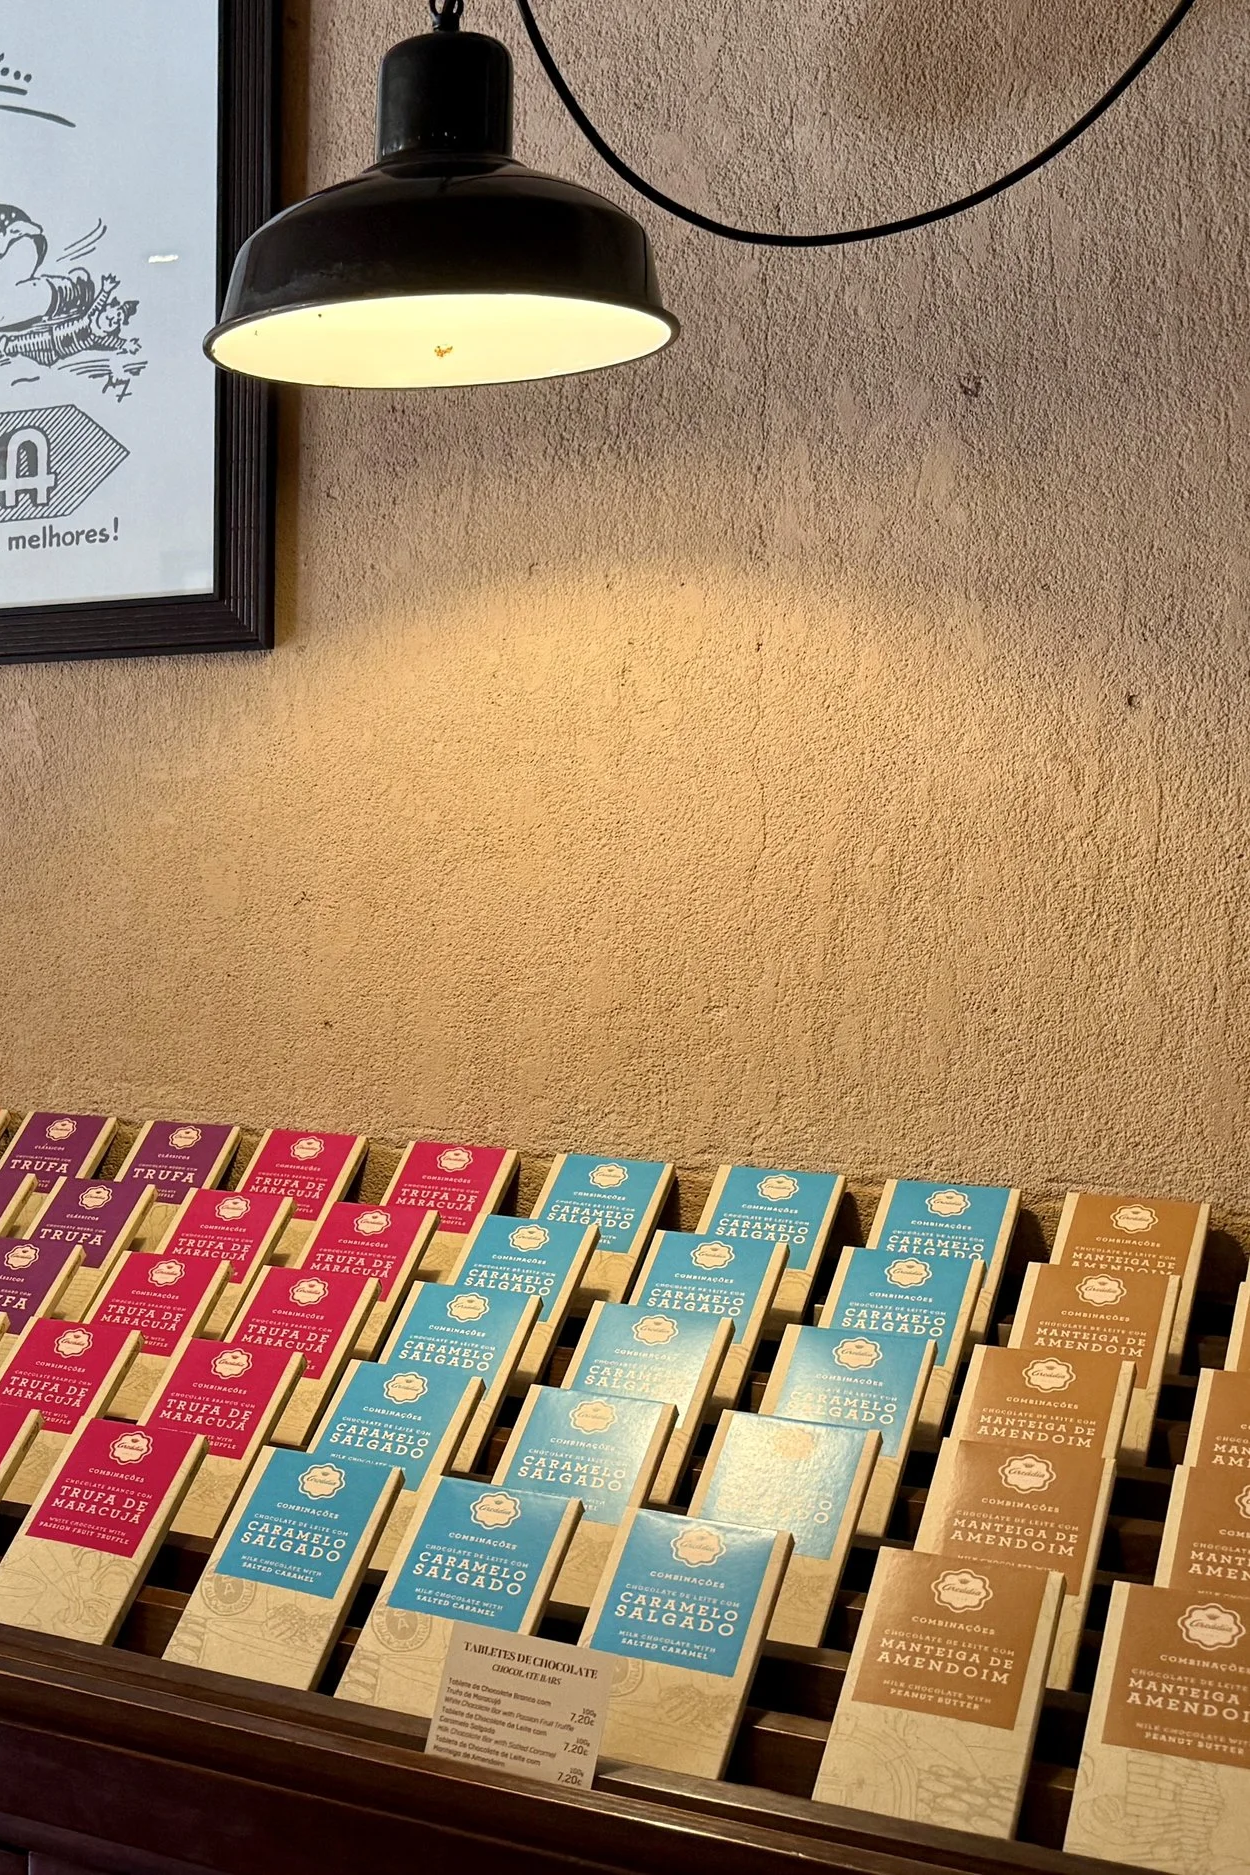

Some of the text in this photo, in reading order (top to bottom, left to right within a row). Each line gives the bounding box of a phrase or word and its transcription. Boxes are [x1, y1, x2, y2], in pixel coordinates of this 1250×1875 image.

[8, 516, 119, 551] melhores!
[10, 1159, 69, 1174] TRUFA
[133, 1168, 195, 1183] TRUFA
[395, 1196, 473, 1212] MARACUJÁ
[400, 1188, 478, 1203] TRUFA DE
[546, 1212, 631, 1230] SALGADO
[551, 1204, 634, 1222] CARAMELO
[715, 1227, 806, 1245] SALGADO
[719, 1218, 809, 1236] CARAMELO
[309, 1262, 389, 1278] MARACUJÁ
[315, 1253, 394, 1270] TRUFA DE
[842, 1318, 943, 1337] SALGADO
[845, 1308, 946, 1327] CARAMELO
[1036, 1326, 1147, 1347] MANTEIGA DE
[404, 1340, 495, 1361] CARAMELO
[1034, 1337, 1144, 1358] AMENDOIM
[398, 1350, 490, 1372] SALGADO
[60, 1486, 148, 1512] TRUFA DE
[52, 1498, 141, 1524] MARACUJÁ
[419, 1552, 527, 1581] CARAMELO
[412, 1563, 522, 1595] SALGADO
[650, 1571, 726, 1589] COMBINAÇÕES
[626, 1584, 677, 1597] CHOCOLATE
[693, 1594, 718, 1604] LEITE
[720, 1599, 740, 1608] COM
[620, 1592, 738, 1622] CARAMELO
[615, 1604, 735, 1636] SALGADO
[912, 1616, 995, 1635] COMBINAÇÕES
[622, 1638, 708, 1660] SALTED CARAMEL
[641, 1634, 691, 1648] CHOCOLATE
[694, 1644, 716, 1653] WITH
[884, 1628, 1015, 1657] CHOCOLATE DE LEITE COM
[464, 1641, 598, 1680] TABLETES DE CHOCOLATE
[880, 1638, 1014, 1670] MANTEIGA DE
[492, 1664, 540, 1681] CHOCOLATE
[876, 1652, 1011, 1685] AMENDOIM
[890, 1688, 980, 1711] PEANUT BUTTER
[908, 1684, 963, 1699] CHOCOLATE
[966, 1694, 992, 1704] WITH
[1128, 1678, 1240, 1706] MANTEIGA
[1126, 1691, 1250, 1723] AMENDOI
